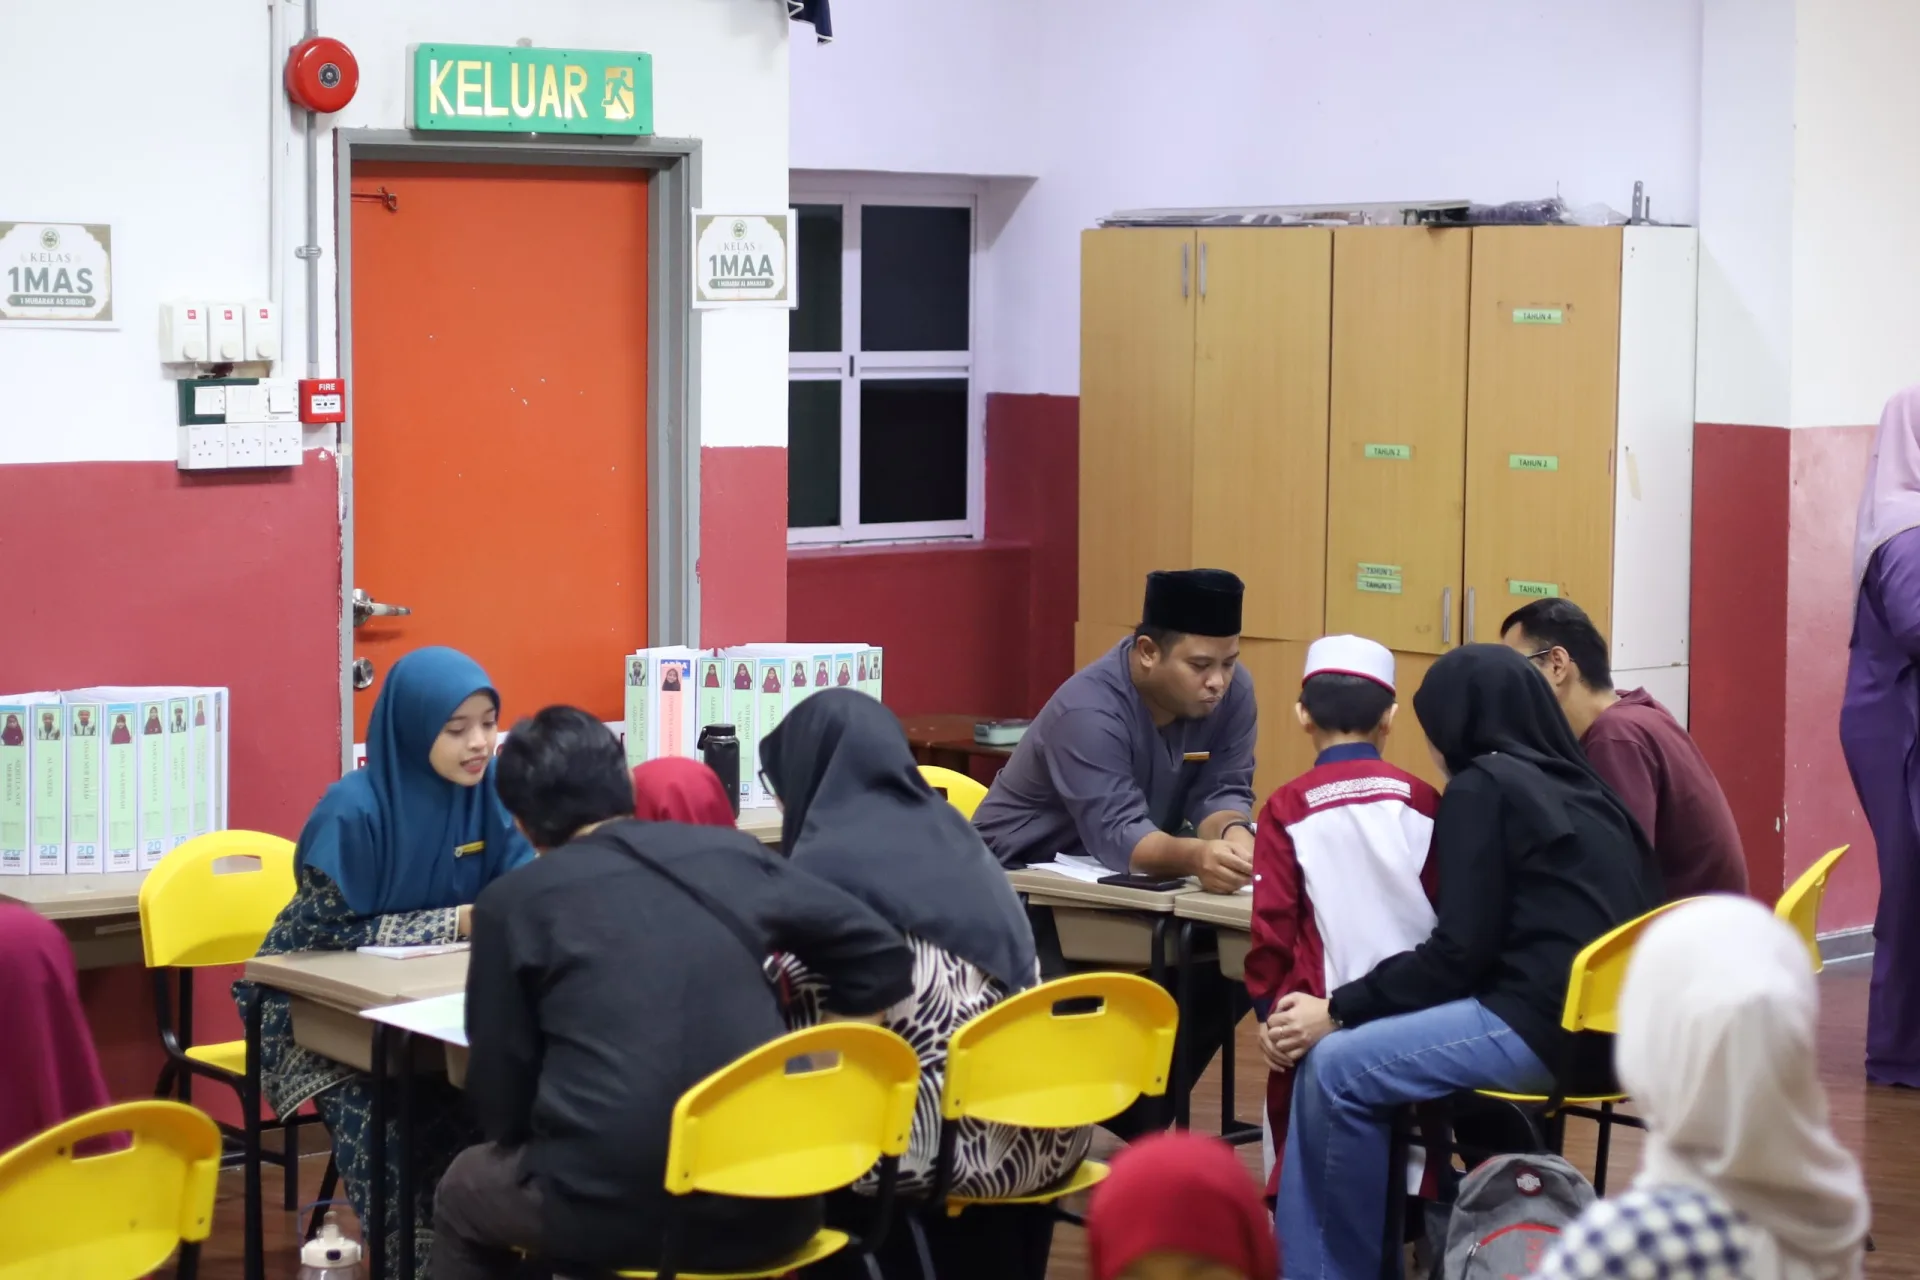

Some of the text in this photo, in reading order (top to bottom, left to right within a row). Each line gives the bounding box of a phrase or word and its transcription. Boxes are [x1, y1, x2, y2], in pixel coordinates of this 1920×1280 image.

[430, 59, 588, 119] KELUAR
[724, 242, 755, 252] KELAS
[30, 252, 72, 264] KELAS
[709, 254, 774, 277] 1MAA
[8, 266, 93, 294] 1MAS
[25, 297, 55, 305] MUBARAK
[1523, 312, 1552, 322] TAHUN 4
[318, 383, 336, 391] FIRE
[1374, 447, 1401, 457] TAHUN 2
[1519, 458, 1547, 469] TAHUN 2
[1366, 567, 1387, 576] TAHUN
[1366, 581, 1387, 590] TAHUN
[1519, 585, 1541, 596] TAHUN
